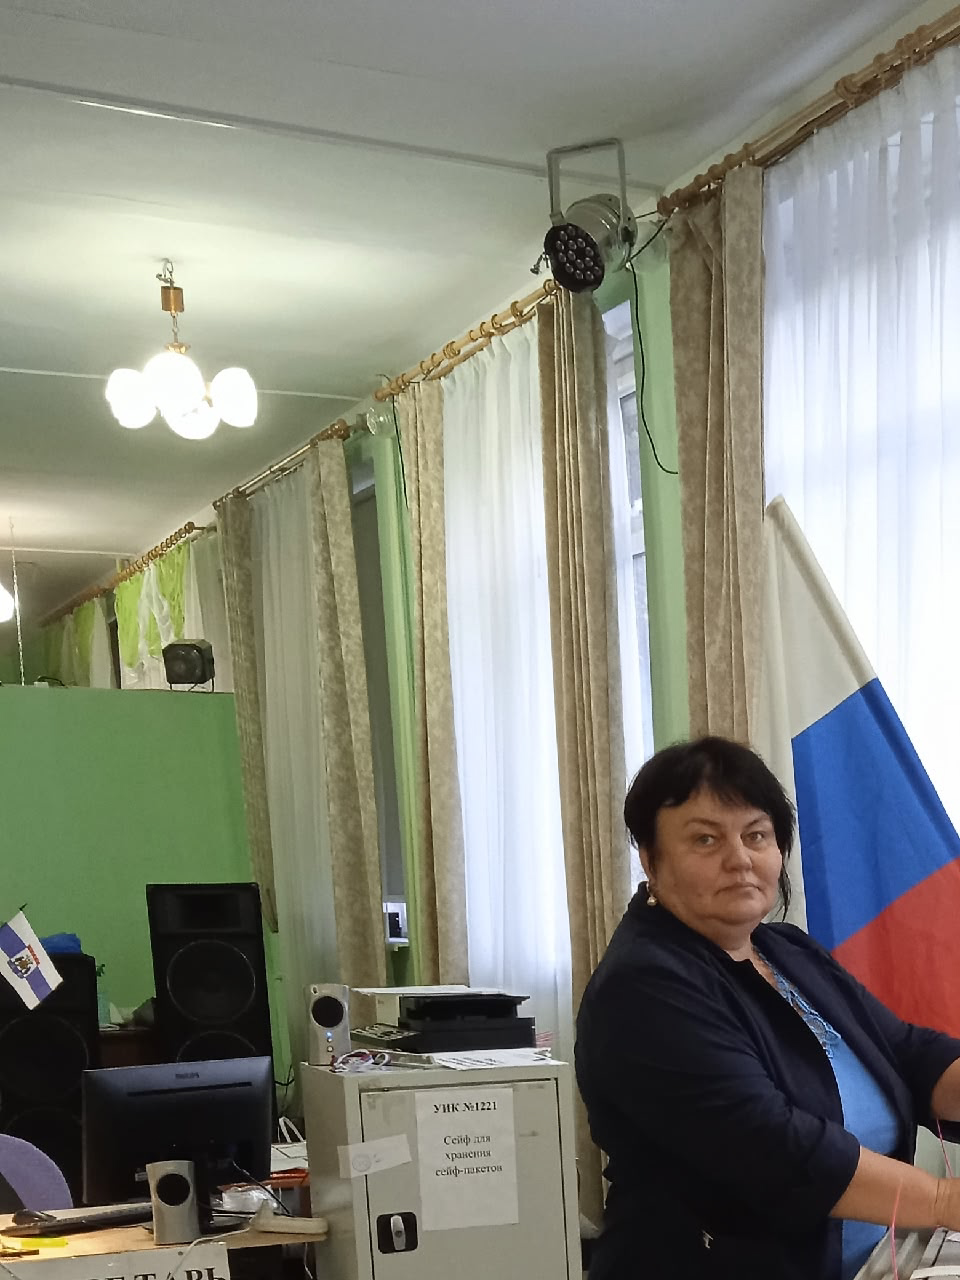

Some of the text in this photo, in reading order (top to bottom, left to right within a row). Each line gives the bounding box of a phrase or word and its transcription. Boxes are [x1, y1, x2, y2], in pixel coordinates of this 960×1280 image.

[433, 1101, 497, 1114] УИК №1221
[443, 1135, 491, 1146] Сейф для
[445, 1149, 491, 1162] хранения
[435, 1165, 503, 1178] сейф-пакетов
